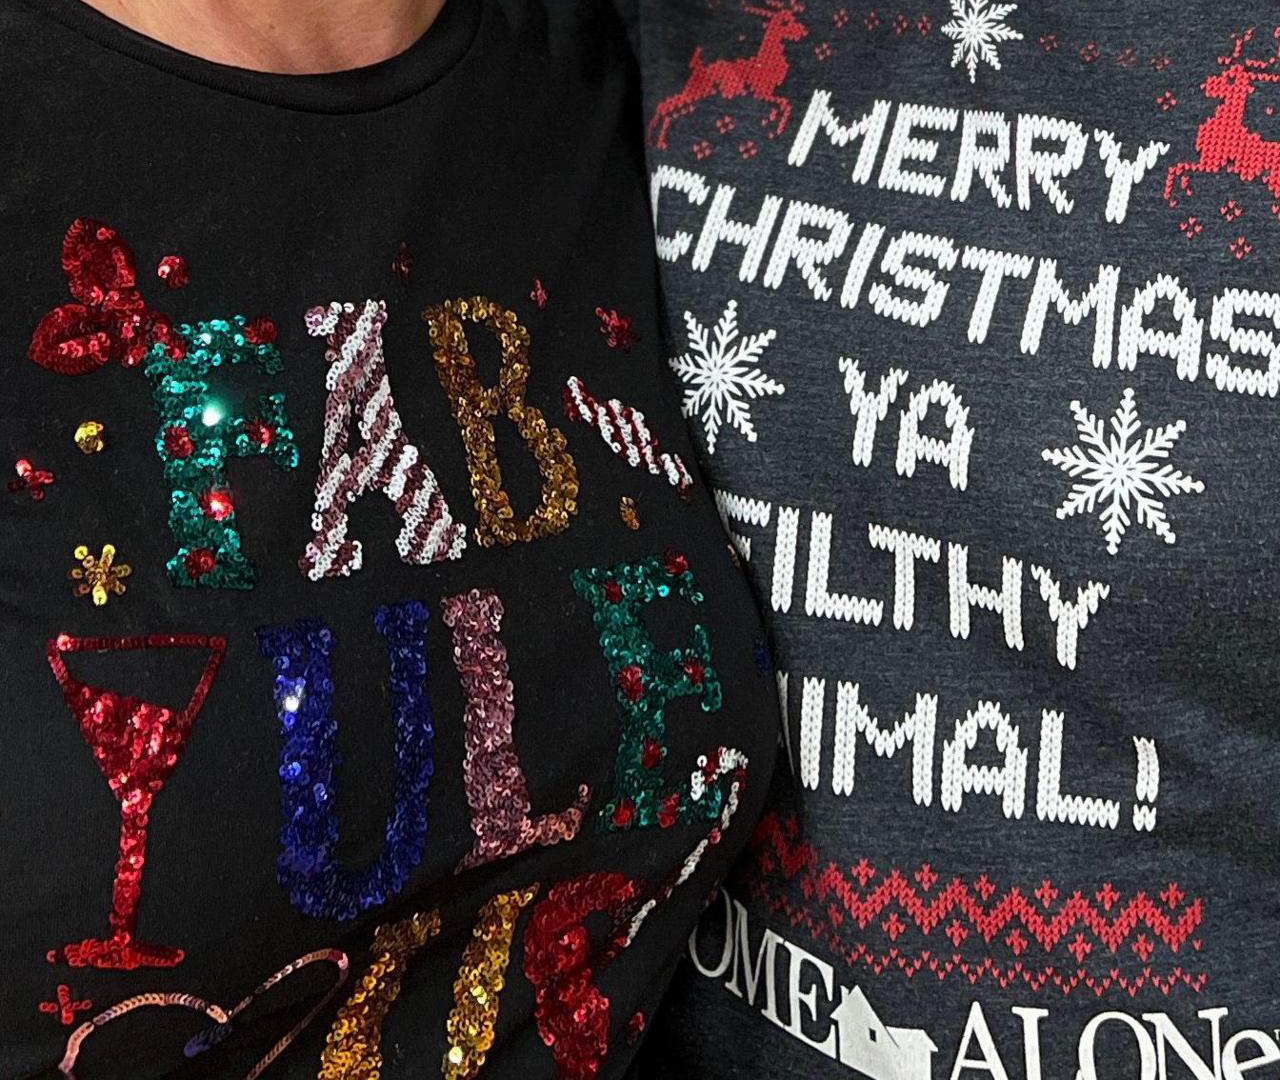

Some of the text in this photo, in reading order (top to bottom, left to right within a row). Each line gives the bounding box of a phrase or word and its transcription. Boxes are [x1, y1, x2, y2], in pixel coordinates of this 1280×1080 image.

[789, 89, 1170, 224] MERRY
[144, 296, 579, 590] FAB
[839, 357, 974, 491] YA
[776, 670, 1160, 832] IMAL!
[688, 886, 840, 1060] OME
